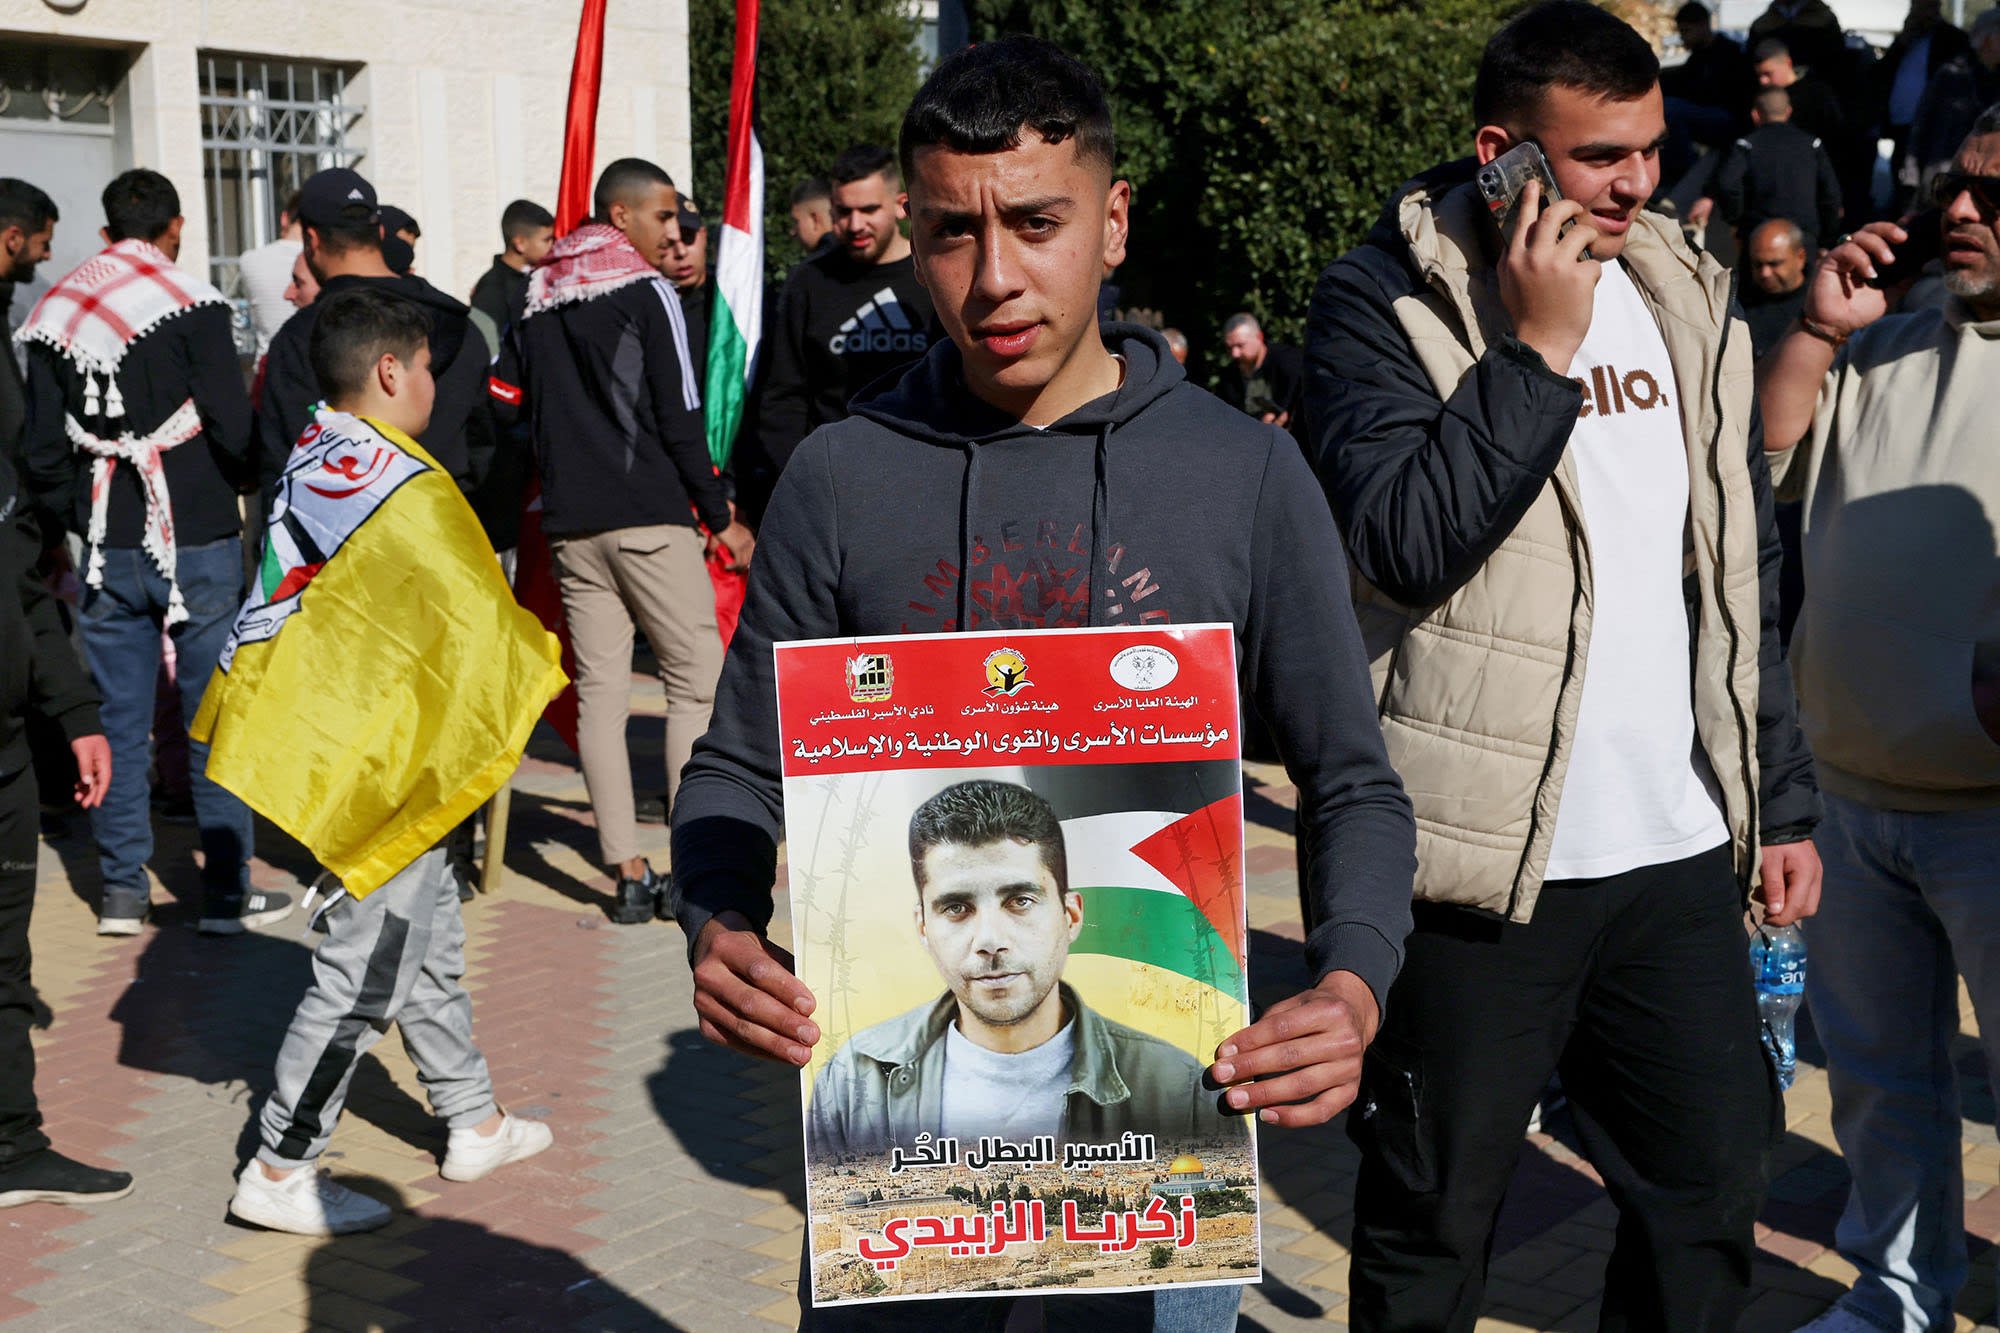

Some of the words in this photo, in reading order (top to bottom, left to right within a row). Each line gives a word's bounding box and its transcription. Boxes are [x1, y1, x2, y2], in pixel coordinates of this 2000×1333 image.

[829, 328, 928, 355] adidas
[872, 704, 907, 720] الأسير
[910, 704, 935, 719] نادي
[960, 700, 999, 716] الأسرى
[1001, 700, 1031, 715] شؤون
[1032, 700, 1060, 713] هيئة
[1093, 697, 1132, 712] للأسرى
[1135, 697, 1164, 709] العليا
[1165, 696, 1199, 709] الهيئة
[809, 708, 870, 726] الفلسطيني
[905, 730, 989, 757] الوطنية
[992, 728, 1060, 754] والقوى
[1063, 721, 1136, 753] الأسرى
[1139, 722, 1230, 749] مؤسسات
[792, 734, 904, 764] والإسلامية
[967, 1137, 1054, 1170] البطل
[1064, 1133, 1154, 1170] الأسير
[858, 1201, 1045, 1271] الزبيدي
[1063, 1196, 1196, 1251] زكريا
